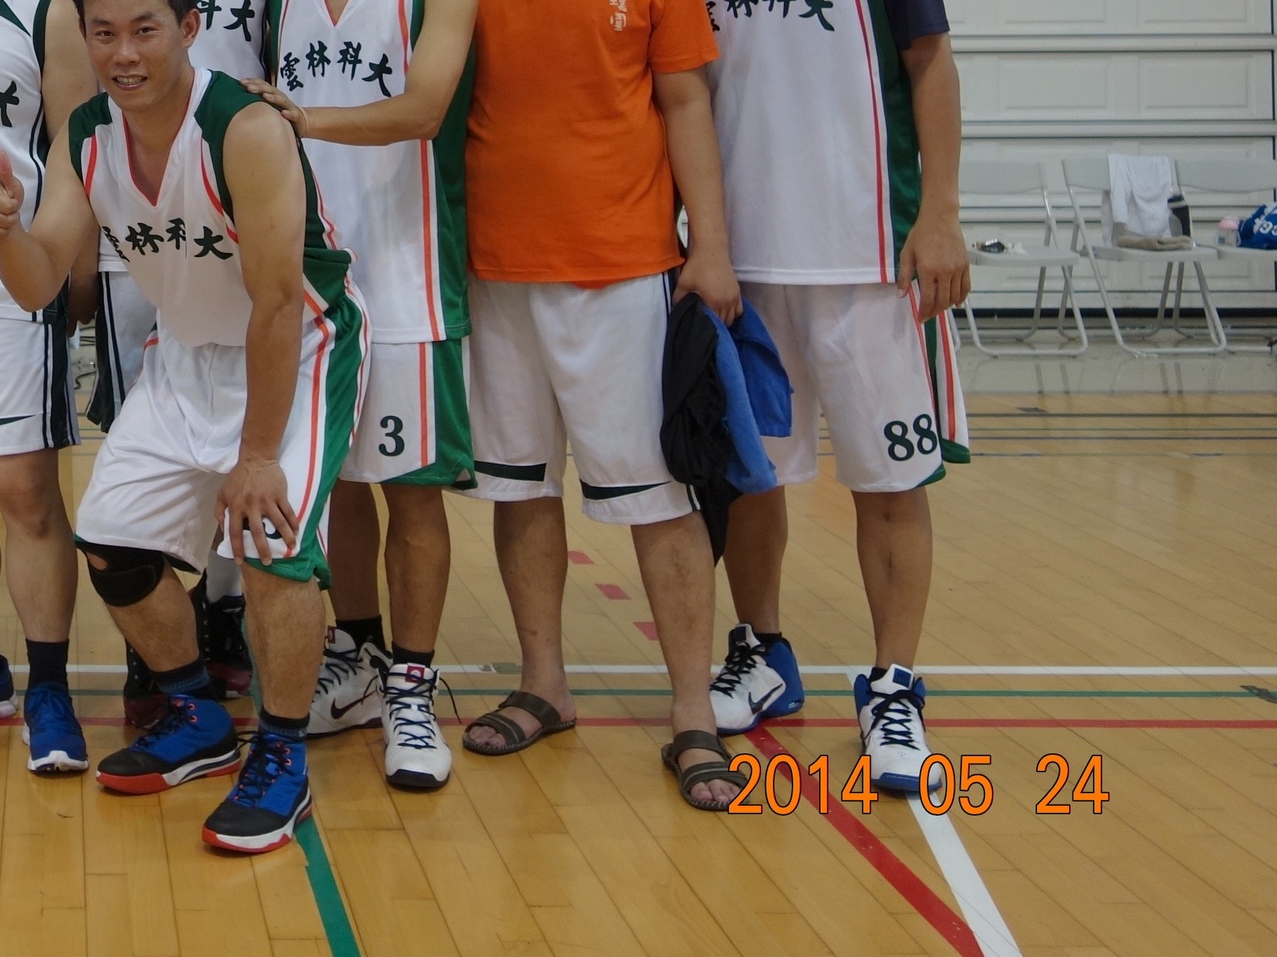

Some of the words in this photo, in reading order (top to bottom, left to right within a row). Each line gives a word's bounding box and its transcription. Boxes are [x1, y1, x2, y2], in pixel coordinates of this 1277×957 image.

[280, 40, 392, 98] 雲林科大
[378, 415, 405, 457] 3
[883, 413, 938, 462] 88
